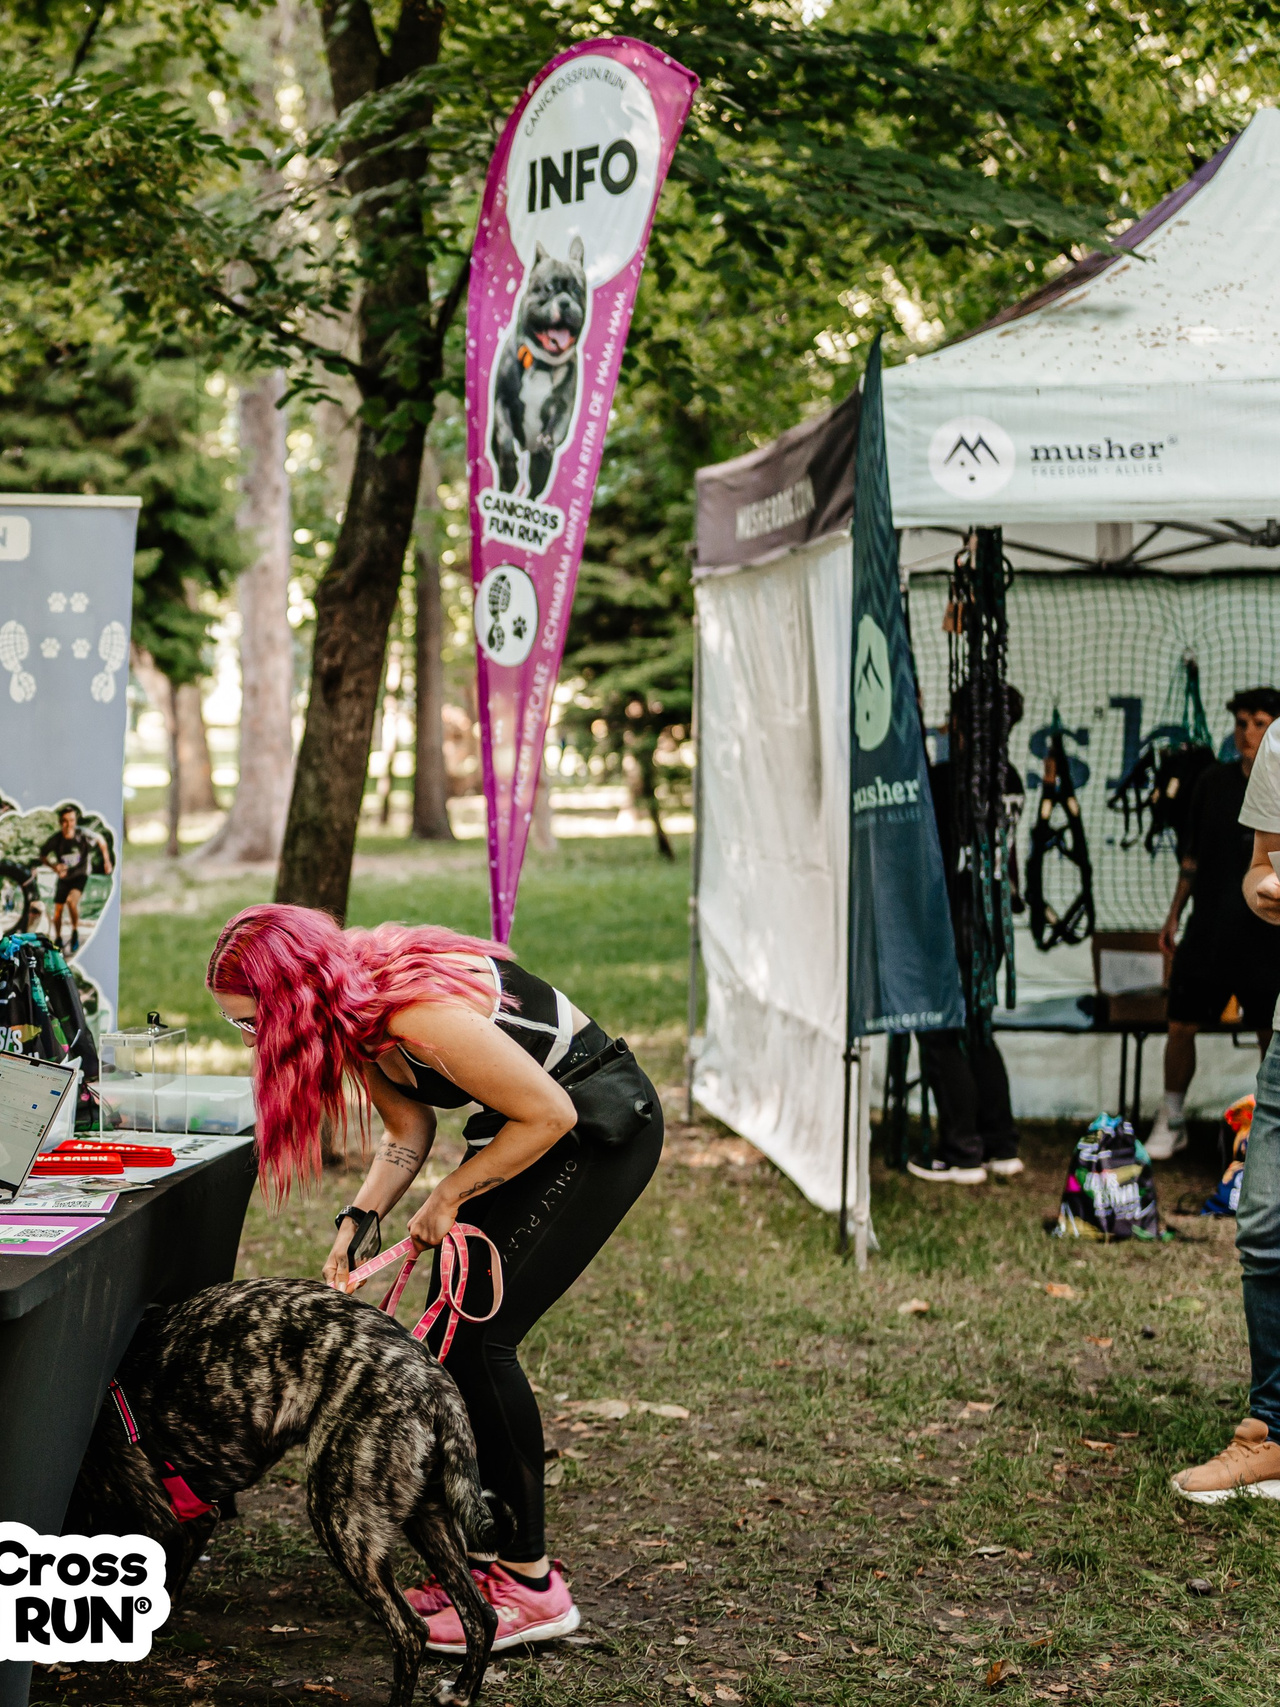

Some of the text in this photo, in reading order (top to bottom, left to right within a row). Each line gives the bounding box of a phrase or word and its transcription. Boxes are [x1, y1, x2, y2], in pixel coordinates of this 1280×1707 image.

[527, 138, 638, 213] INFO
[489, 516, 515, 538] FUN
[540, 1160, 577, 1212] ONLY
